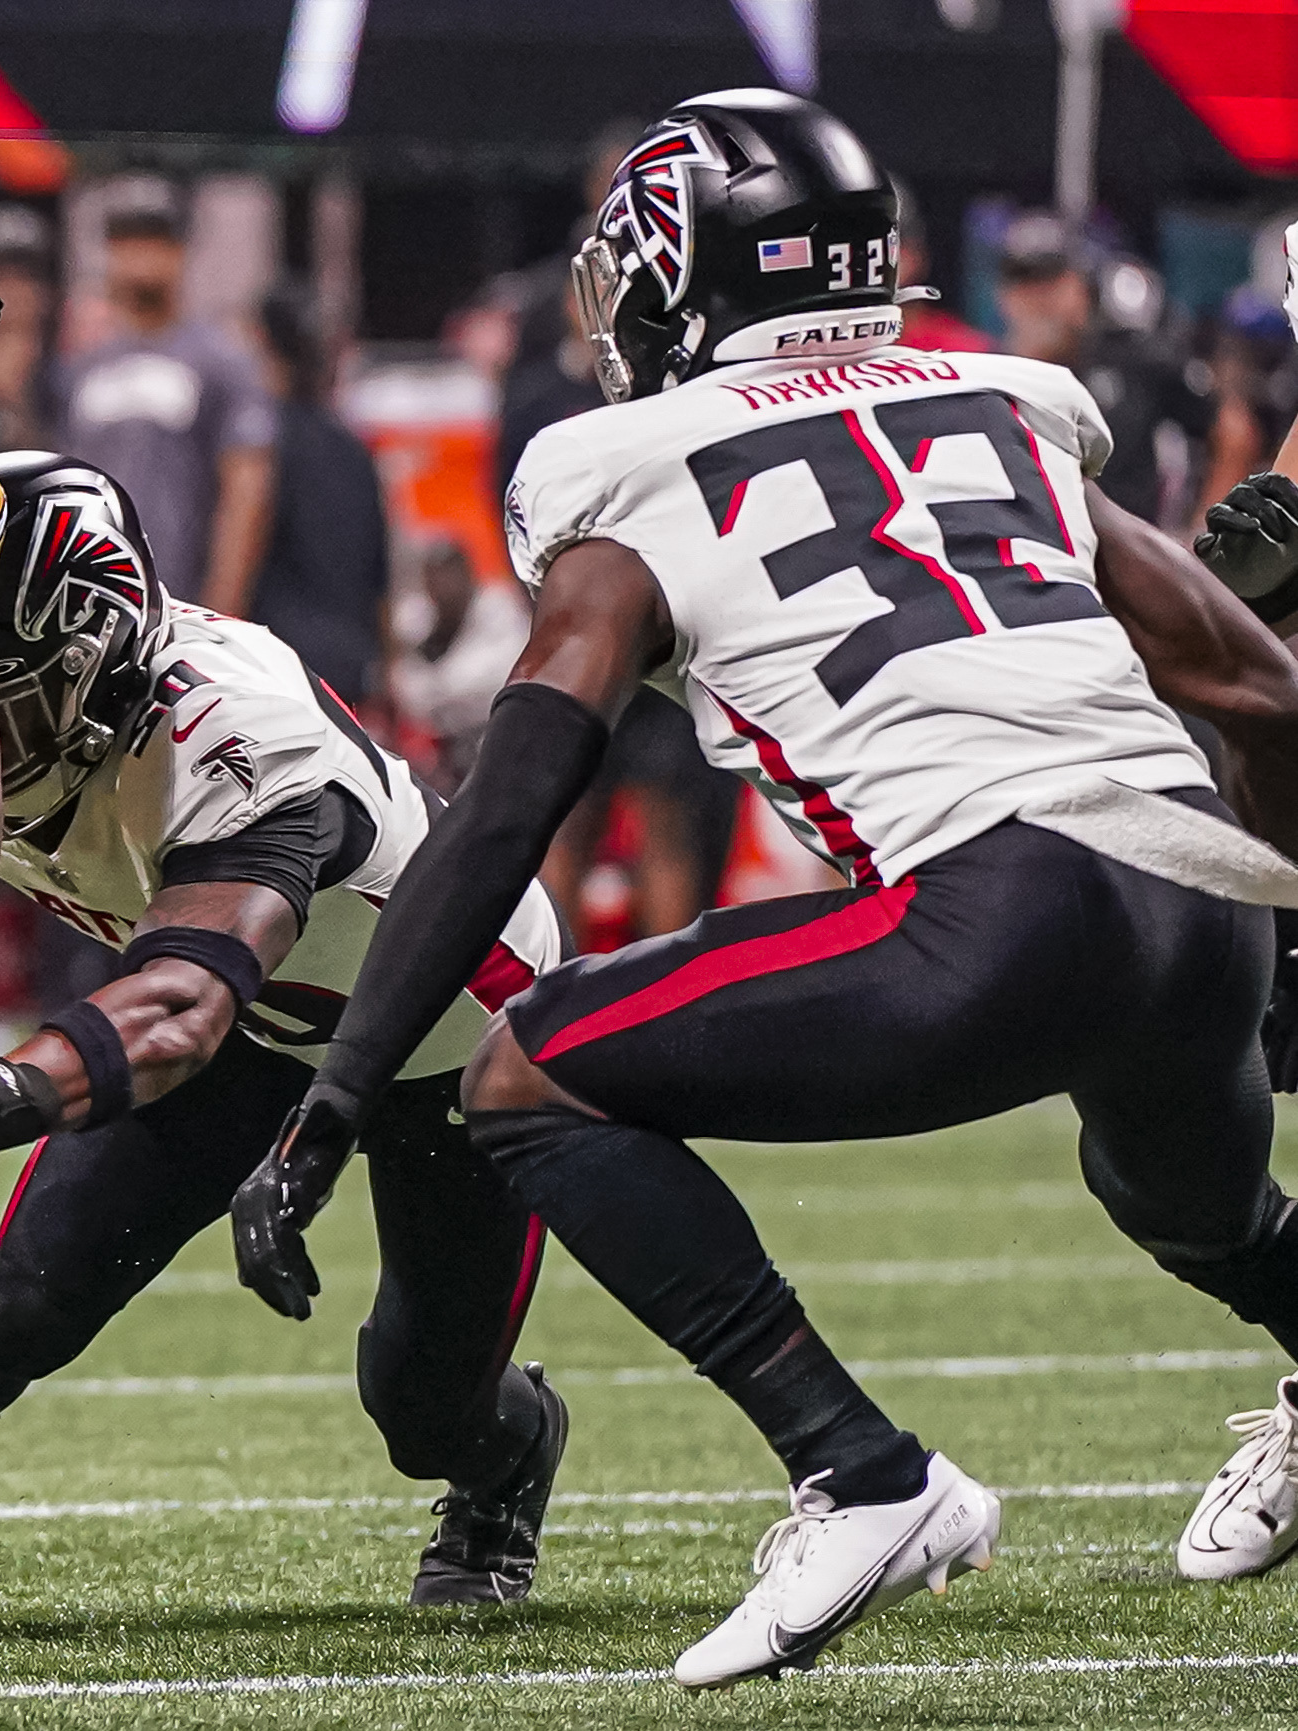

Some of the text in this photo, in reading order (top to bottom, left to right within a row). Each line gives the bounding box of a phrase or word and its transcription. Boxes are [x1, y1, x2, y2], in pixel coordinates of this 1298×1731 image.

[827, 238, 884, 291] 32
[718, 358, 961, 410] HAWKINS
[687, 387, 1111, 709] 32
